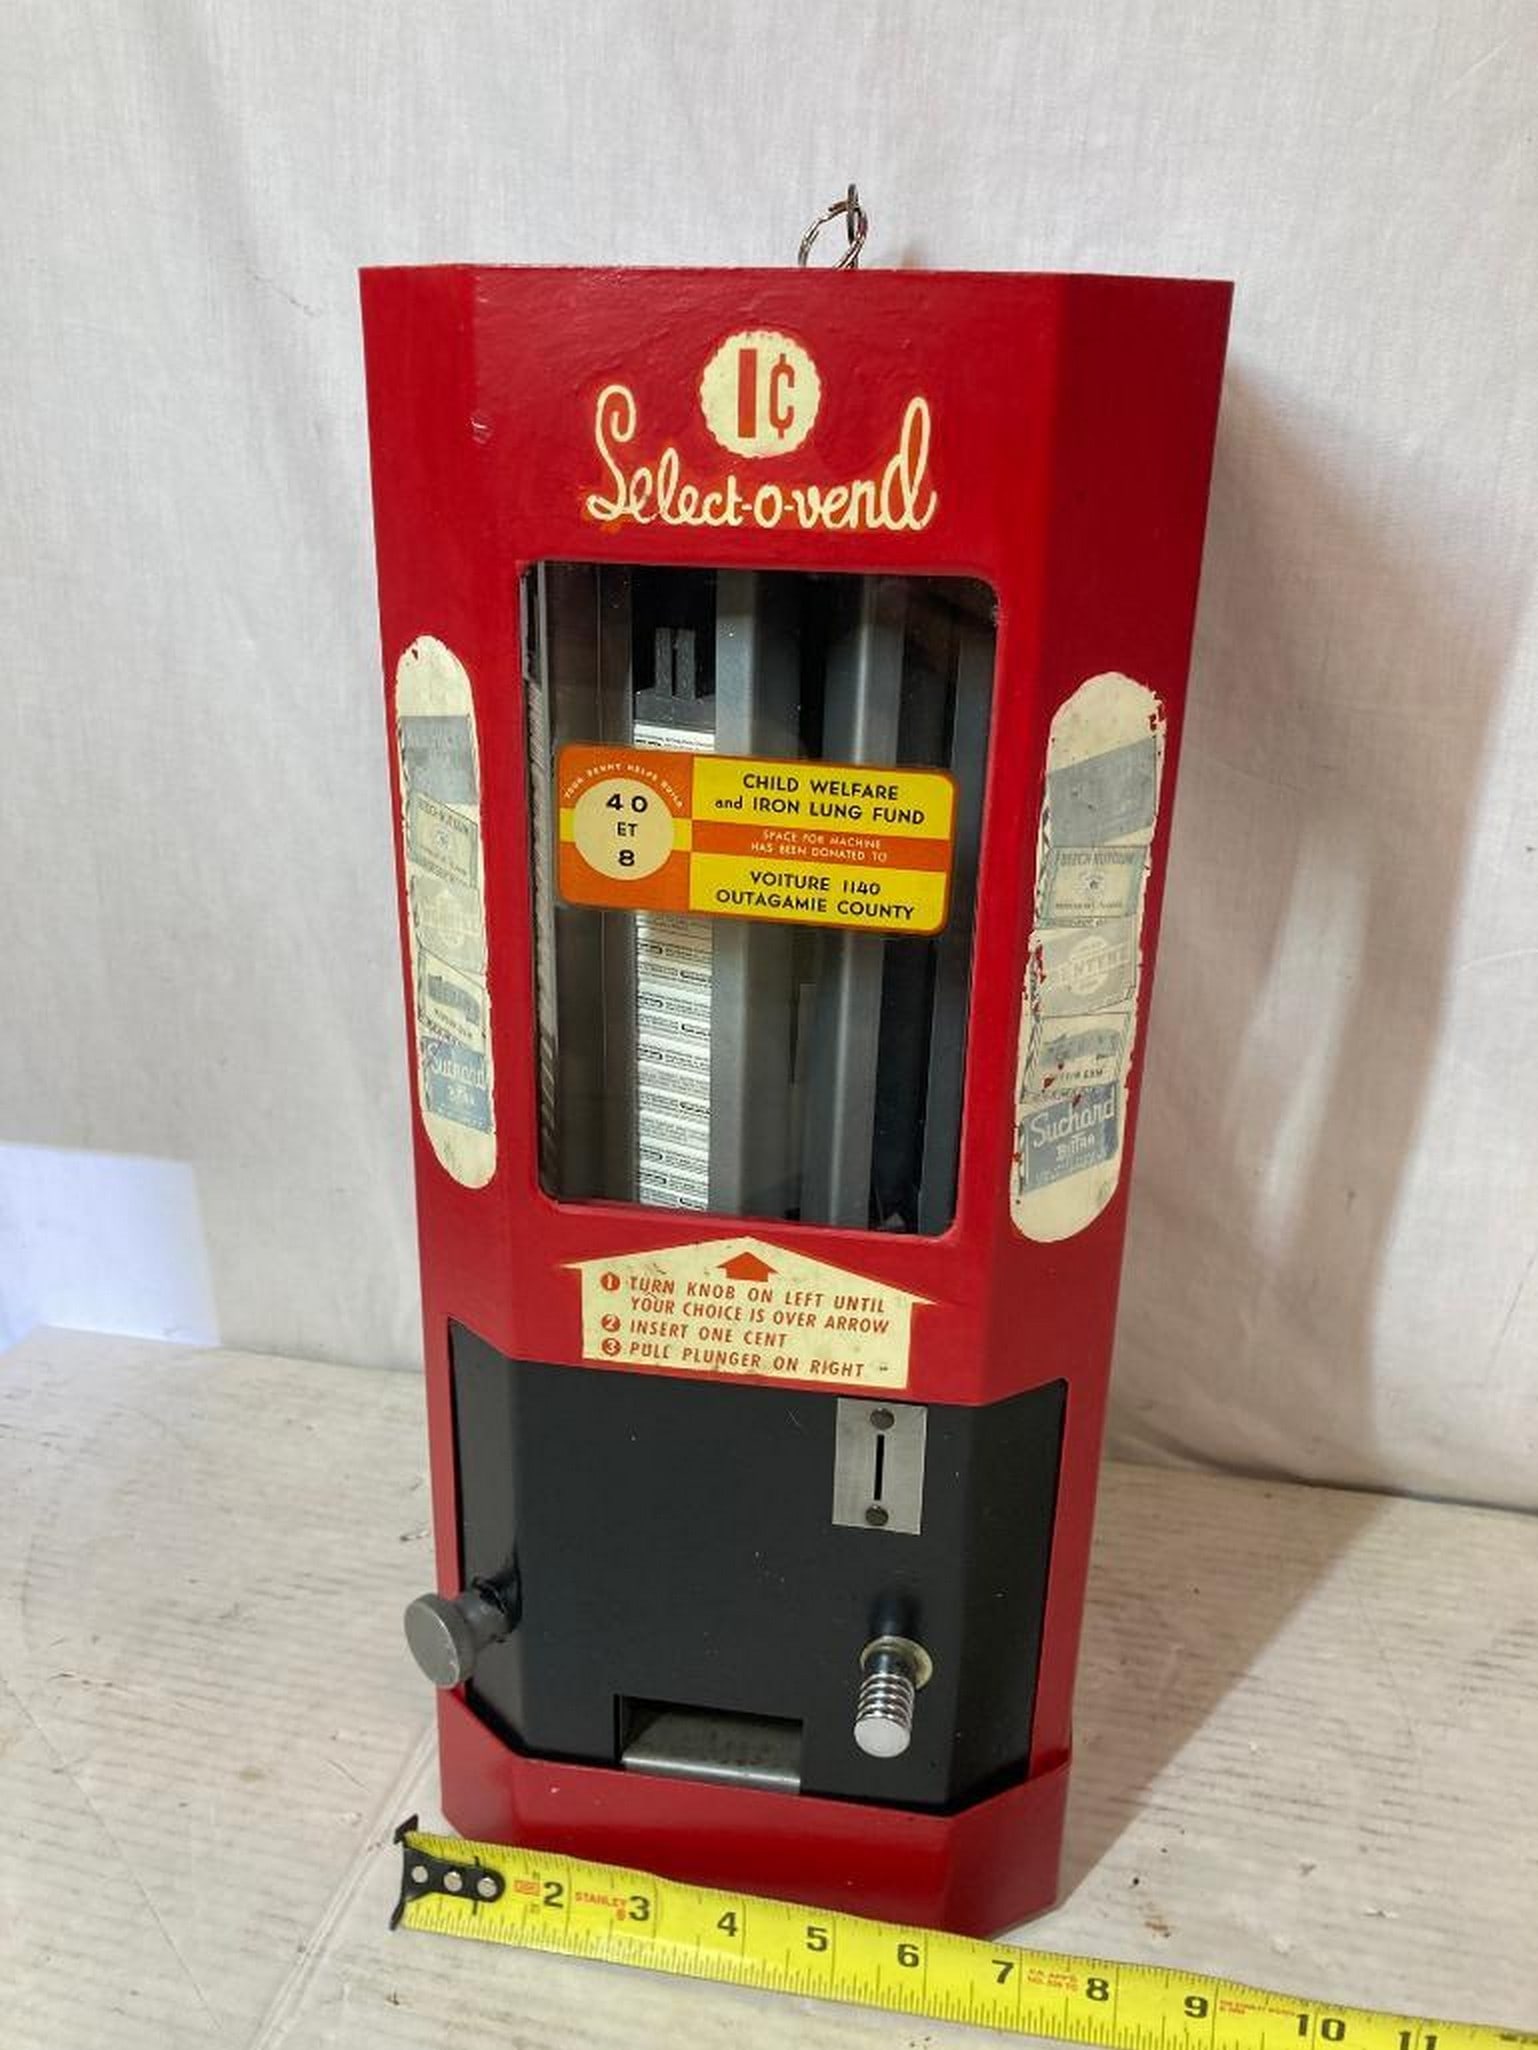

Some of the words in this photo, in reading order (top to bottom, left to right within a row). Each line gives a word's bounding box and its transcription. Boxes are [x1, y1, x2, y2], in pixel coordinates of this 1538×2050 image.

[586, 384, 938, 531] Select-o-vend
[742, 772, 800, 794] CHILD
[810, 779, 899, 801] WELFARE
[715, 795, 744, 812] and
[752, 797, 801, 815] IRON
[809, 801, 862, 821] LUNG
[872, 806, 925, 827] FUND
[616, 822, 639, 838] ET
[762, 829, 799, 842] SPACE
[802, 833, 825, 845] FOR
[829, 836, 882, 850] MACHINE
[617, 849, 636, 867] 8
[751, 841, 774, 853] HAS
[779, 844, 807, 856] BEEN
[811, 847, 866, 862] DONATED
[871, 851, 888, 863] TO
[750, 871, 831, 892] VOITURE
[842, 880, 882, 896] 1140
[715, 888, 828, 914] OUTAGAMIE
[837, 899, 915, 921] COUNTY
[630, 1276, 675, 1295] TURN
[686, 1281, 736, 1300] KNOB
[747, 1287, 773, 1304] ON
[785, 1291, 825, 1308] LEFT
[833, 1295, 885, 1314] UNTIL
[630, 1297, 675, 1315] YOUR
[683, 1304, 743, 1323] CHOICE
[750, 1308, 765, 1324] IS
[773, 1310, 817, 1329] OVER
[824, 1315, 890, 1334] ARROW
[630, 1320, 688, 1340] INSERT
[699, 1326, 732, 1343] ONE
[743, 1331, 788, 1348] CENT
[629, 1341, 670, 1360] PULL
[682, 1347, 761, 1369] PLUNGER
[773, 1356, 799, 1372] ON
[810, 1359, 865, 1377] RIGHT
[543, 1881, 564, 1908] 2
[575, 1891, 627, 1908] STANLEY
[629, 1895, 650, 1921] 3
[716, 1911, 738, 1938] 4
[805, 1925, 829, 1953] 5
[896, 1942, 921, 1968] 6
[991, 1959, 1014, 1984] 7
[1086, 1978, 1109, 2001] 8
[1184, 1996, 1208, 2018] 9
[1296, 2014, 1346, 2041] 10
